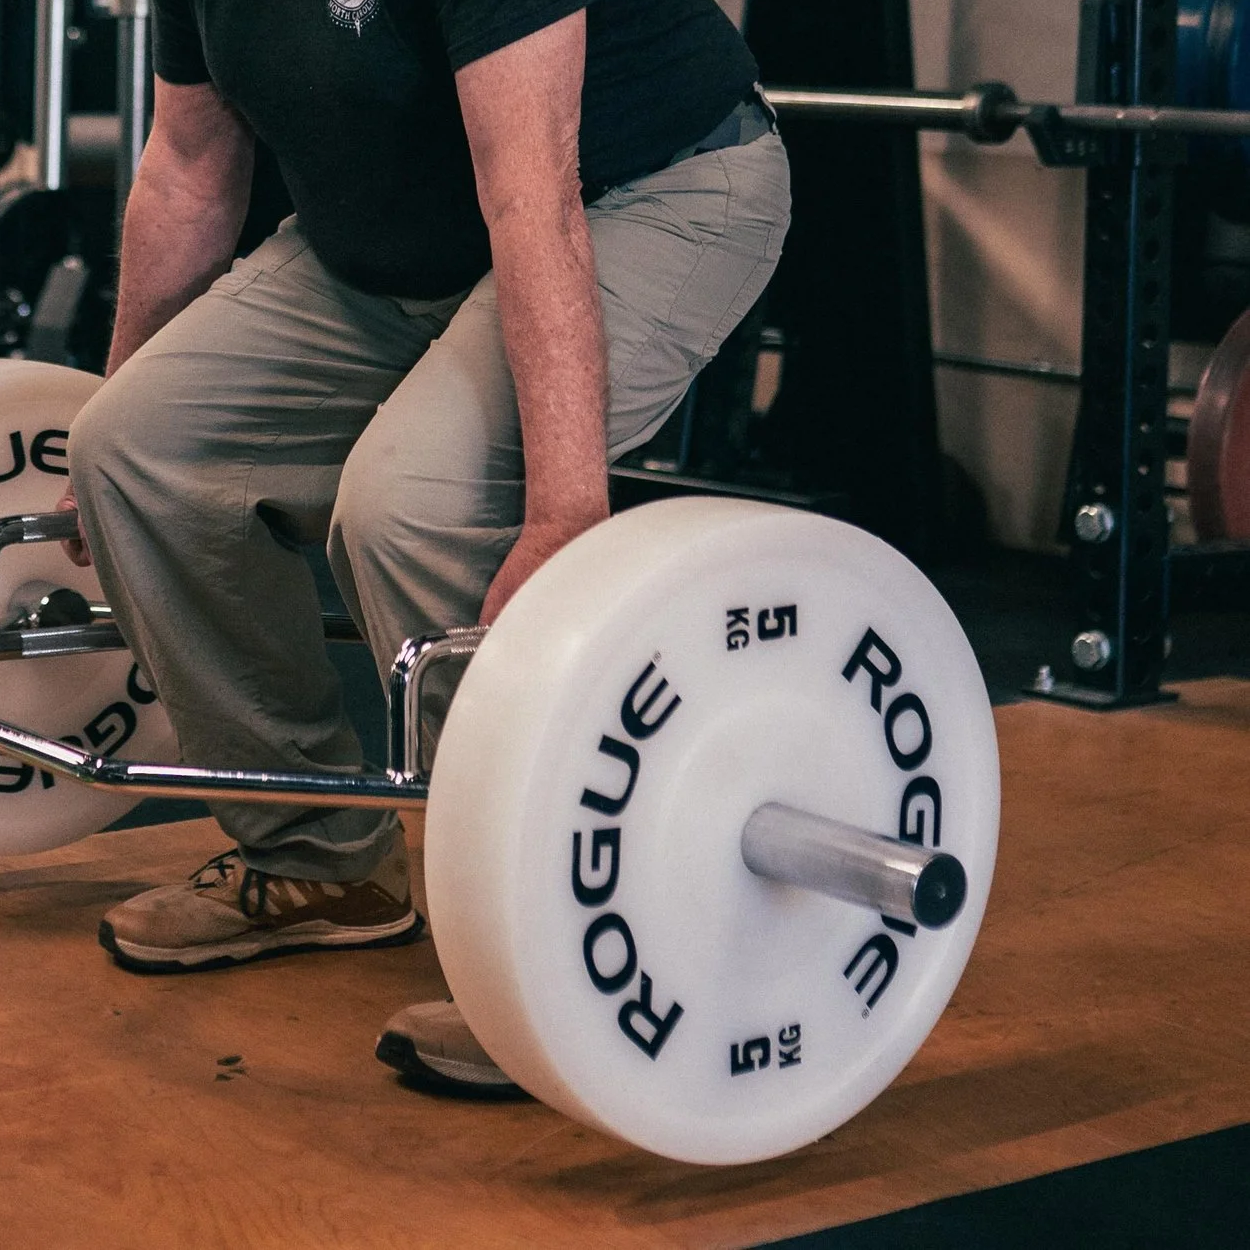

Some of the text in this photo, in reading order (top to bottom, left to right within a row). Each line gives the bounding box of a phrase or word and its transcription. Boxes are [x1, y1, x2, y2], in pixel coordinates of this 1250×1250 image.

[327, 0, 351, 20] NORTH
[727, 605, 799, 653] 5 KG
[842, 627, 942, 1012] ROGE
[572, 661, 685, 1062] ROGUE
[730, 1023, 802, 1078] 5 KG
